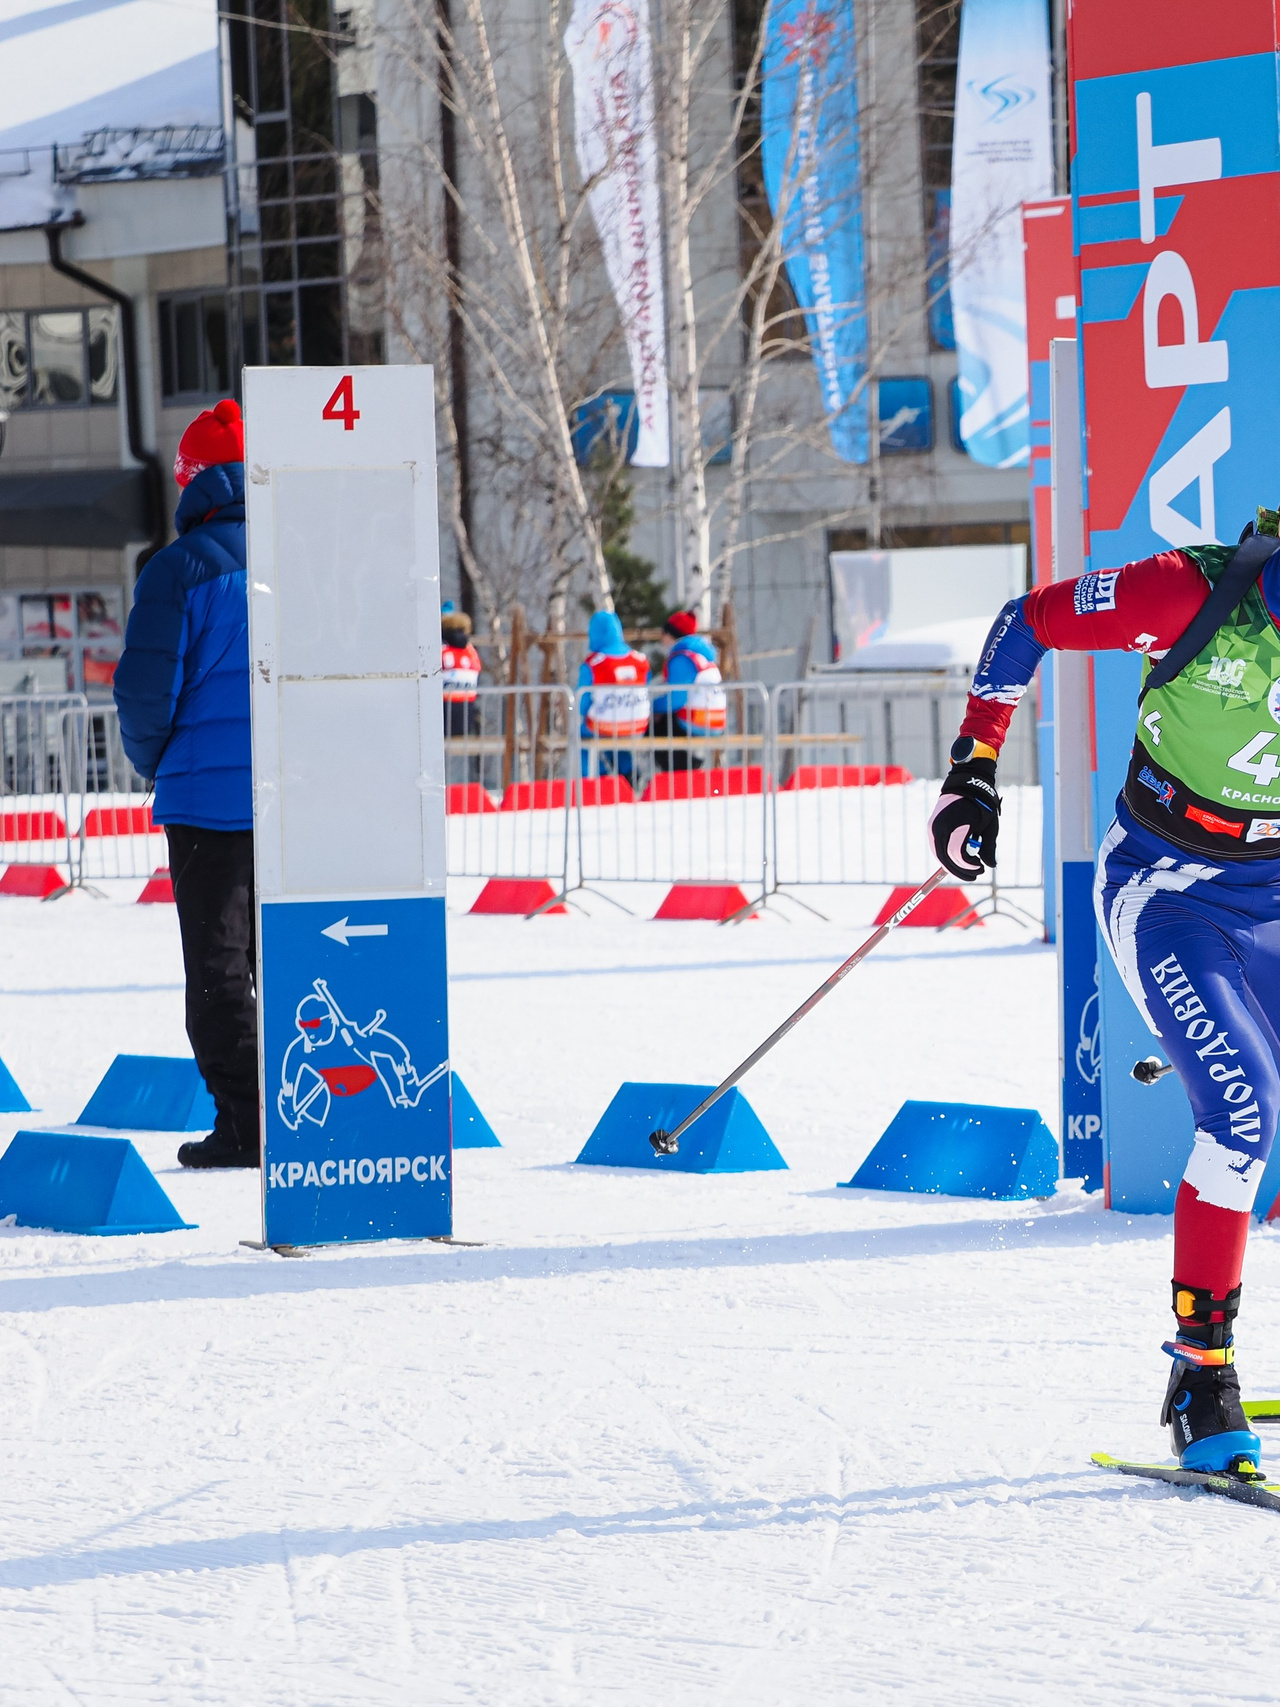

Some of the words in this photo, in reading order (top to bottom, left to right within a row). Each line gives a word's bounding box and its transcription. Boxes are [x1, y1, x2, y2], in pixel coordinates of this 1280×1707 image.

[1136, 91, 1231, 547] АРТ
[322, 375, 361, 431] 4
[966, 776, 997, 797] SWIX
[885, 890, 926, 932] SWIX
[1149, 952, 1262, 1144] МОРДОВИЯ
[270, 1154, 447, 1188] КРАСНОЯРСК
[1173, 1348, 1204, 1361] SALOMON
[1180, 1413, 1194, 1444] SALOMON
[1208, 1476, 1230, 1489] FISCHER
